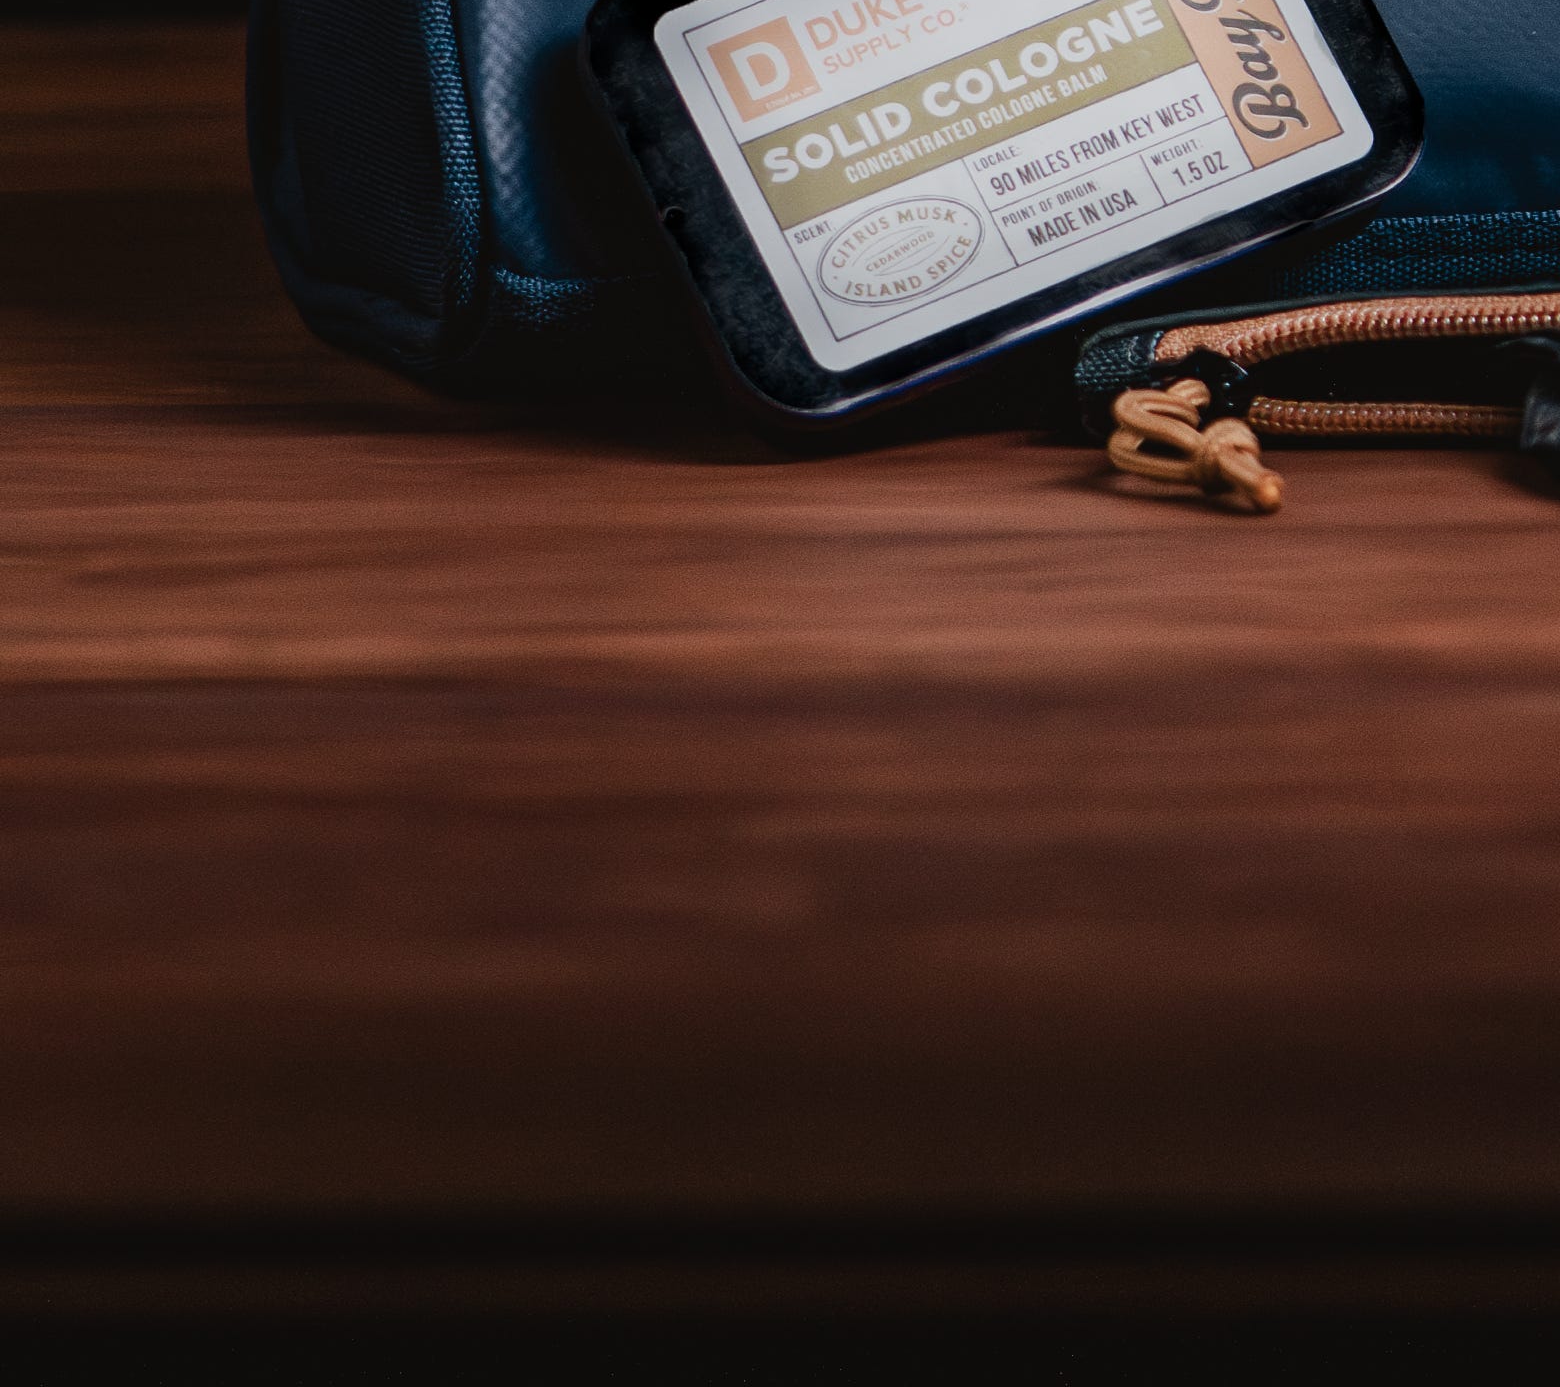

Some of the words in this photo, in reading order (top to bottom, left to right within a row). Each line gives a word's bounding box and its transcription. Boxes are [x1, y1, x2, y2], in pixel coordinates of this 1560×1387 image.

[729, 41, 791, 101] D
[823, 25, 915, 75] SUPPLY
[1219, 9, 1310, 139] Bay
[763, 101, 912, 184] SOLID
[845, 117, 978, 184] CONCENTRATED
[978, 86, 1056, 129] COLOGNE
[1056, 64, 1109, 98] BALM
[990, 164, 1017, 196] 90
[1018, 150, 1071, 187] MILES
[1070, 129, 1122, 164] FROM
[1119, 114, 1156, 144] KEY
[1155, 94, 1206, 128] WEST
[1150, 137, 1204, 167] WEIGHT:
[1172, 159, 1204, 188] 1.5
[1205, 150, 1230, 174] OZ
[831, 215, 890, 269] CITRUS
[897, 206, 957, 225] MUSK
[1001, 205, 1037, 228] POINT
[1039, 200, 1055, 214] OF
[1027, 210, 1077, 247] MADE
[1077, 204, 1102, 227] IN
[1102, 187, 1139, 218] USA
[845, 275, 923, 298] ISLAND
[926, 235, 973, 280] SPICE
[865, 230, 936, 273] CEDARWOOD
